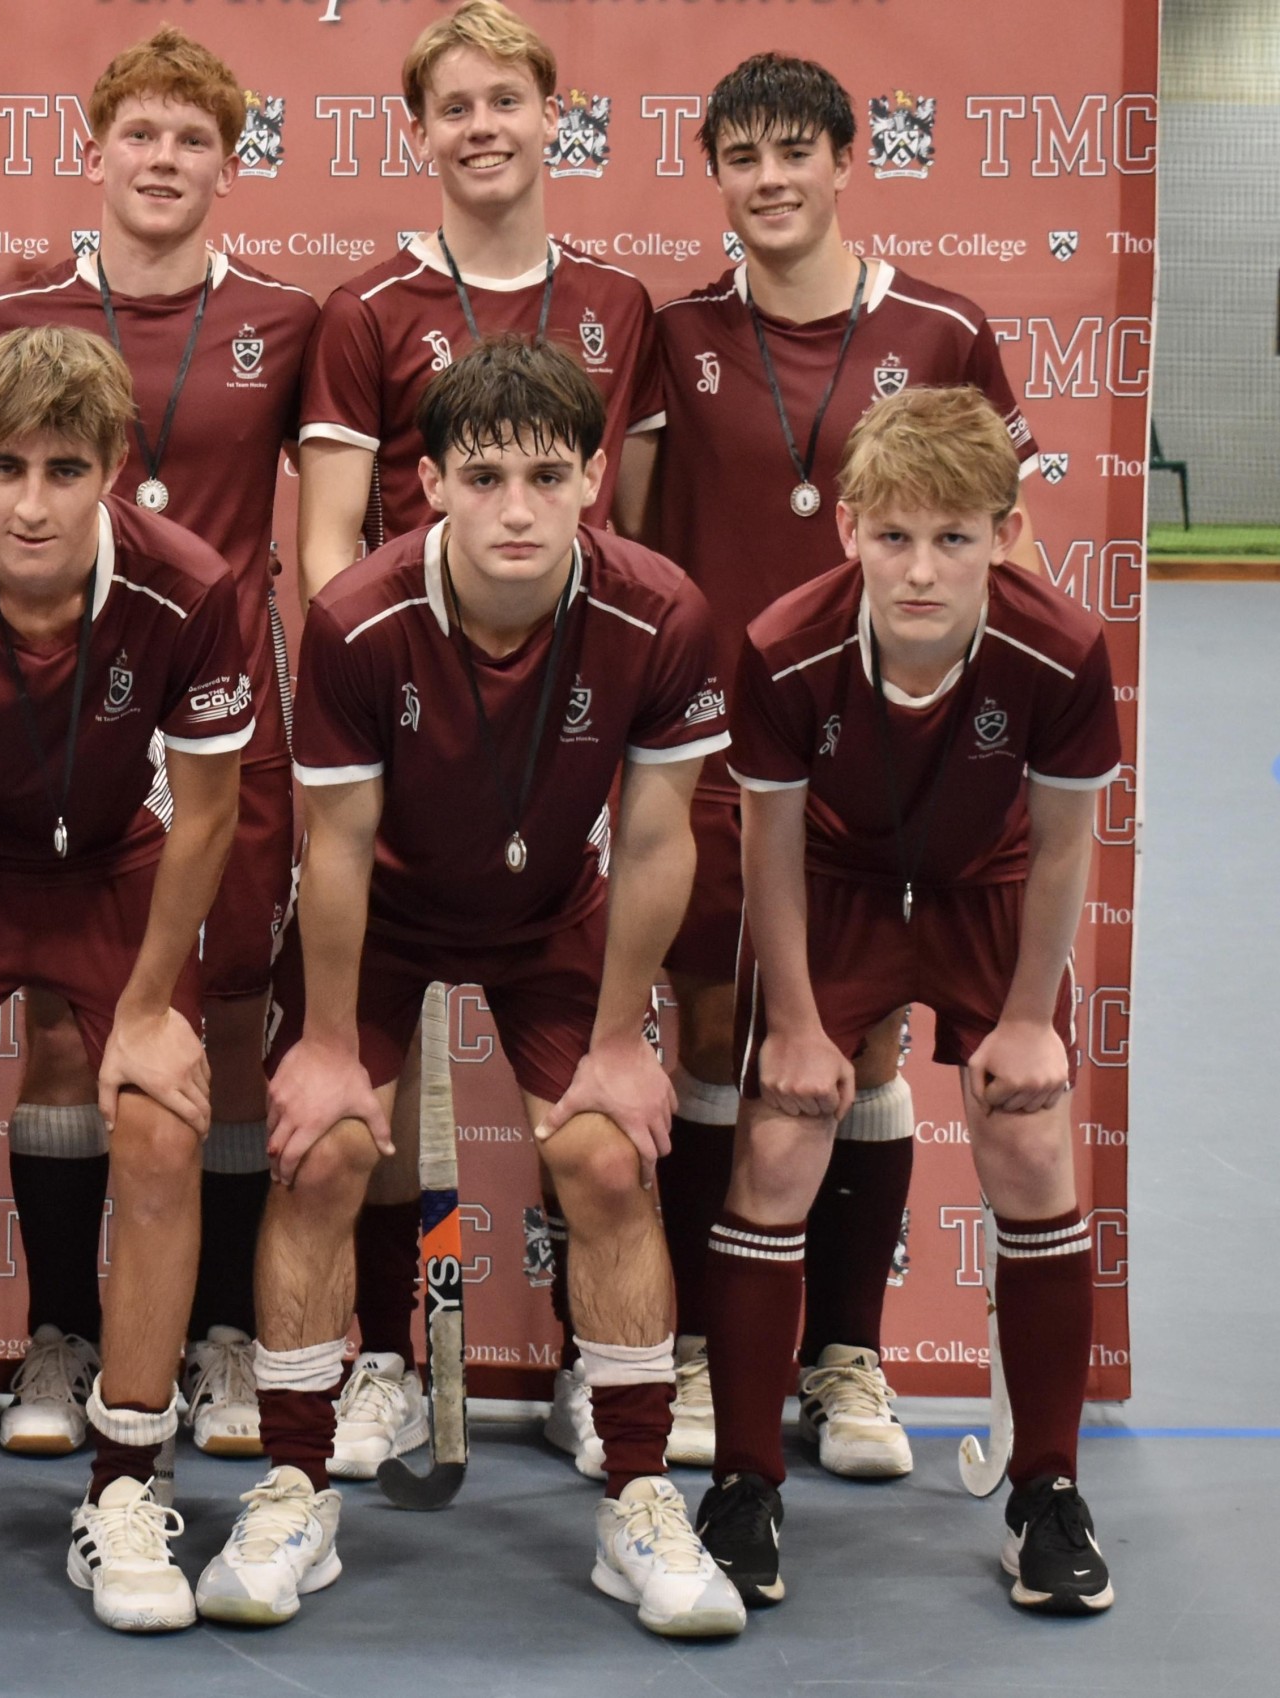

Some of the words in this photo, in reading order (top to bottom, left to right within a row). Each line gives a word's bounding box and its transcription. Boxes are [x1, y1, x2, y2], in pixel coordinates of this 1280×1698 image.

[316, 96, 440, 177] TM
[966, 94, 1158, 177] TMC
[221, 233, 282, 255] More
[288, 233, 375, 261] College
[613, 233, 701, 261] College
[872, 234, 932, 257] More
[938, 235, 1027, 261] College
[1106, 232, 1156, 253] Tho
[1096, 454, 1147, 477] Tho
[208, 687, 225, 696] THE
[229, 690, 252, 716] GUY
[1084, 902, 1134, 924] Tho
[914, 1121, 971, 1144] Colle
[1079, 1123, 1128, 1145] Tho
[427, 1255, 461, 1323] YS
[463, 1345, 521, 1363] omas
[915, 1340, 991, 1369] Colleg
